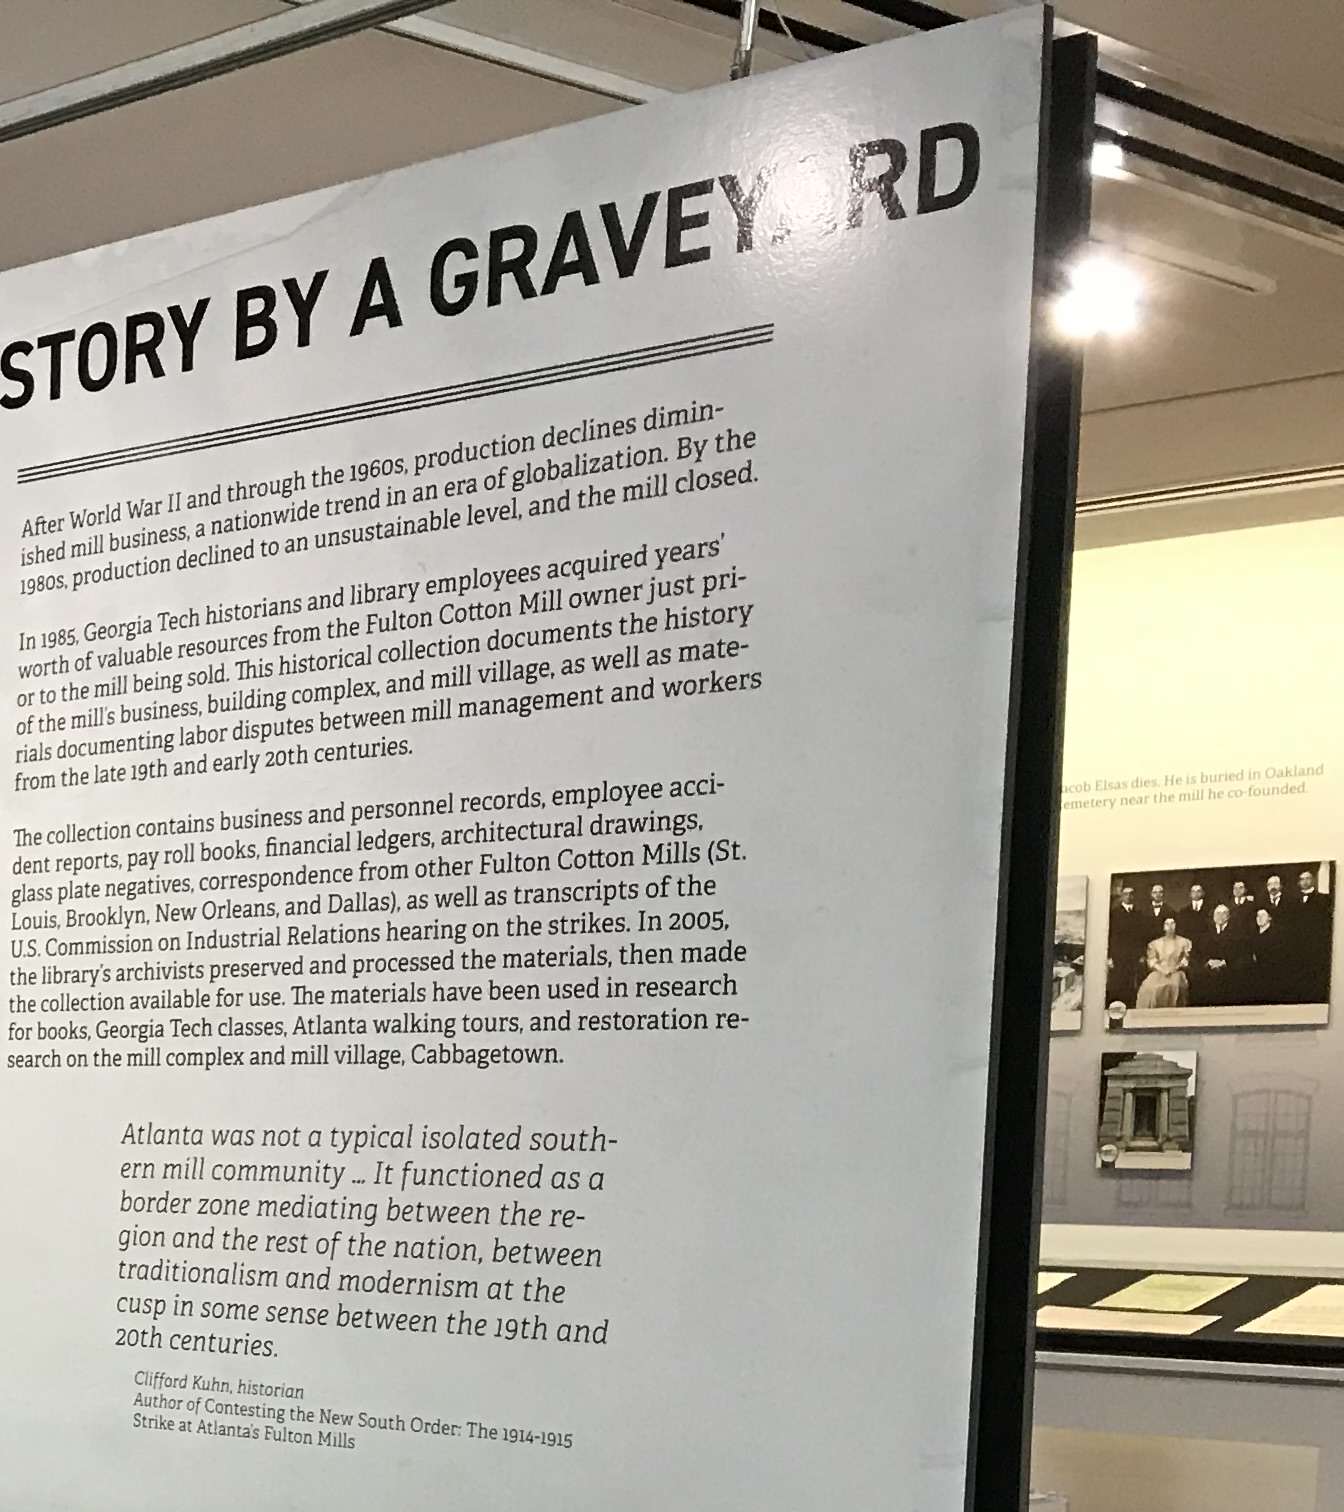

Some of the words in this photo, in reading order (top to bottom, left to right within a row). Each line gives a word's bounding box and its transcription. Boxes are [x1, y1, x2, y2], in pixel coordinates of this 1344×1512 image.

[235, 269, 329, 361] BY
[349, 256, 403, 337] A
[429, 122, 981, 317] GRAVEYRD
[21, 515, 65, 539] After
[68, 501, 122, 530] World
[126, 497, 164, 520] War
[167, 491, 182, 514] II
[186, 483, 222, 510] and
[226, 469, 307, 503] through
[311, 465, 345, 489] the
[349, 457, 409, 483] 1960s,
[413, 433, 536, 477] production
[541, 417, 637, 450] declines
[643, 400, 724, 432] dimin-
[20, 540, 66, 567] ished
[70, 533, 104, 559] mill
[109, 525, 191, 553] business,
[195, 522, 206, 538] a
[210, 499, 320, 536] nationwide
[325, 487, 381, 517] trend
[385, 485, 407, 508] in
[412, 483, 439, 503] an
[443, 477, 478, 498] era
[483, 465, 510, 491] of
[510, 445, 669, 493] globalization.
[676, 436, 709, 464] By
[714, 428, 757, 454] the
[19, 574, 69, 596] 1980s,
[72, 555, 172, 592] production
[176, 538, 255, 571] declined
[259, 539, 280, 558] to
[284, 535, 309, 554] an
[314, 507, 462, 549] unsustainable
[466, 496, 523, 527] level,
[528, 488, 571, 517] and
[576, 484, 616, 510] the
[621, 472, 669, 503] mill
[674, 459, 759, 495] closed.
[16, 691, 36, 708] or
[39, 688, 57, 705] to
[60, 681, 90, 703] the
[93, 674, 128, 699] mill
[132, 671, 184, 694] being
[186, 661, 231, 688] sold.
[234, 657, 274, 681] This
[278, 644, 372, 677] historical
[377, 634, 481, 664] collection
[486, 619, 613, 652] documents
[618, 611, 658, 637] the
[663, 603, 755, 632] history
[1060, 792, 1117, 810] emetery
[1120, 793, 1150, 807] near
[1153, 791, 1175, 804] the
[1178, 788, 1204, 803] mill
[1208, 787, 1224, 801] he
[1227, 781, 1308, 799] co-founded.
[1061, 780, 1091, 794] acob
[1095, 779, 1128, 792] Elsas
[1131, 776, 1161, 790] dies.
[1164, 774, 1183, 787] He
[1186, 773, 1197, 786] is
[1200, 768, 1244, 784] buried
[1248, 768, 1261, 781] in
[1265, 763, 1324, 780] Oakland
[12, 827, 43, 848] The
[46, 820, 132, 845] collection
[135, 813, 215, 838] contains
[219, 808, 303, 832] business
[307, 800, 346, 825] and
[350, 791, 454, 827] personnel
[459, 786, 546, 813] records,
[551, 779, 664, 810] employee
[669, 772, 725, 798] acci-
[8, 1021, 33, 1041] for
[36, 1020, 92, 1042] books,
[95, 1017, 165, 1044] Georgia
[169, 1016, 213, 1038] Tech
[217, 1016, 288, 1038] classes,
[291, 1014, 368, 1036] Atlanta
[371, 1012, 457, 1039] walking
[461, 1013, 524, 1035] tours,
[529, 1009, 572, 1032] and
[576, 1007, 709, 1032] restoration
[714, 1012, 750, 1030] re-
[120, 1121, 204, 1146] Atlanta
[211, 1129, 256, 1147] was
[261, 1126, 302, 1148] not
[307, 1129, 322, 1148] a
[330, 1123, 414, 1155] typical
[421, 1124, 522, 1151] isolated
[528, 1125, 618, 1153] south-
[120, 1162, 155, 1179] ern
[161, 1155, 205, 1180] mill
[211, 1159, 346, 1190] community
[373, 1160, 395, 1185] It
[400, 1160, 544, 1192] functioned
[550, 1170, 581, 1190] as
[588, 1171, 605, 1191] a
[120, 1189, 193, 1215] border
[196, 1198, 251, 1217] zone
[256, 1193, 378, 1228] mediating
[386, 1196, 490, 1225] between
[499, 1200, 542, 1227] the
[548, 1209, 586, 1229] re-
[118, 1223, 166, 1252] gion
[172, 1225, 215, 1250] and
[222, 1226, 259, 1252] the
[264, 1233, 310, 1255] rest
[315, 1230, 343, 1261] of
[347, 1231, 387, 1258] the
[392, 1235, 483, 1265] nation,
[491, 1236, 602, 1268] between
[118, 1258, 279, 1288] traditionalism
[285, 1266, 331, 1292] and
[336, 1269, 478, 1299] modernism
[487, 1279, 515, 1301] at
[523, 1276, 566, 1304] the
[114, 1325, 163, 1349] 20th
[169, 1332, 278, 1358] centuries.
[116, 1296, 167, 1321] cusp
[173, 1293, 194, 1317] in
[199, 1301, 260, 1322] some
[264, 1305, 330, 1326] sense
[336, 1302, 437, 1333] between
[446, 1309, 488, 1337] the
[493, 1314, 548, 1341] 19th
[556, 1318, 609, 1345] and
[134, 1370, 188, 1390] Clifford
[191, 1375, 233, 1395] Kuhn,
[236, 1378, 304, 1400] historian
[132, 1392, 184, 1411] Author
[186, 1396, 203, 1416] of
[204, 1398, 286, 1424] Contesting
[289, 1405, 315, 1423] the
[319, 1408, 354, 1426] New
[357, 1412, 406, 1432] South
[466, 1421, 498, 1441] The
[502, 1427, 573, 1449] 1914-1915
[133, 1412, 176, 1432] Strike
[177, 1420, 192, 1433] at
[196, 1419, 260, 1440] Atlanta's
[264, 1425, 313, 1445] Fulton
[317, 1430, 356, 1449] Mills
